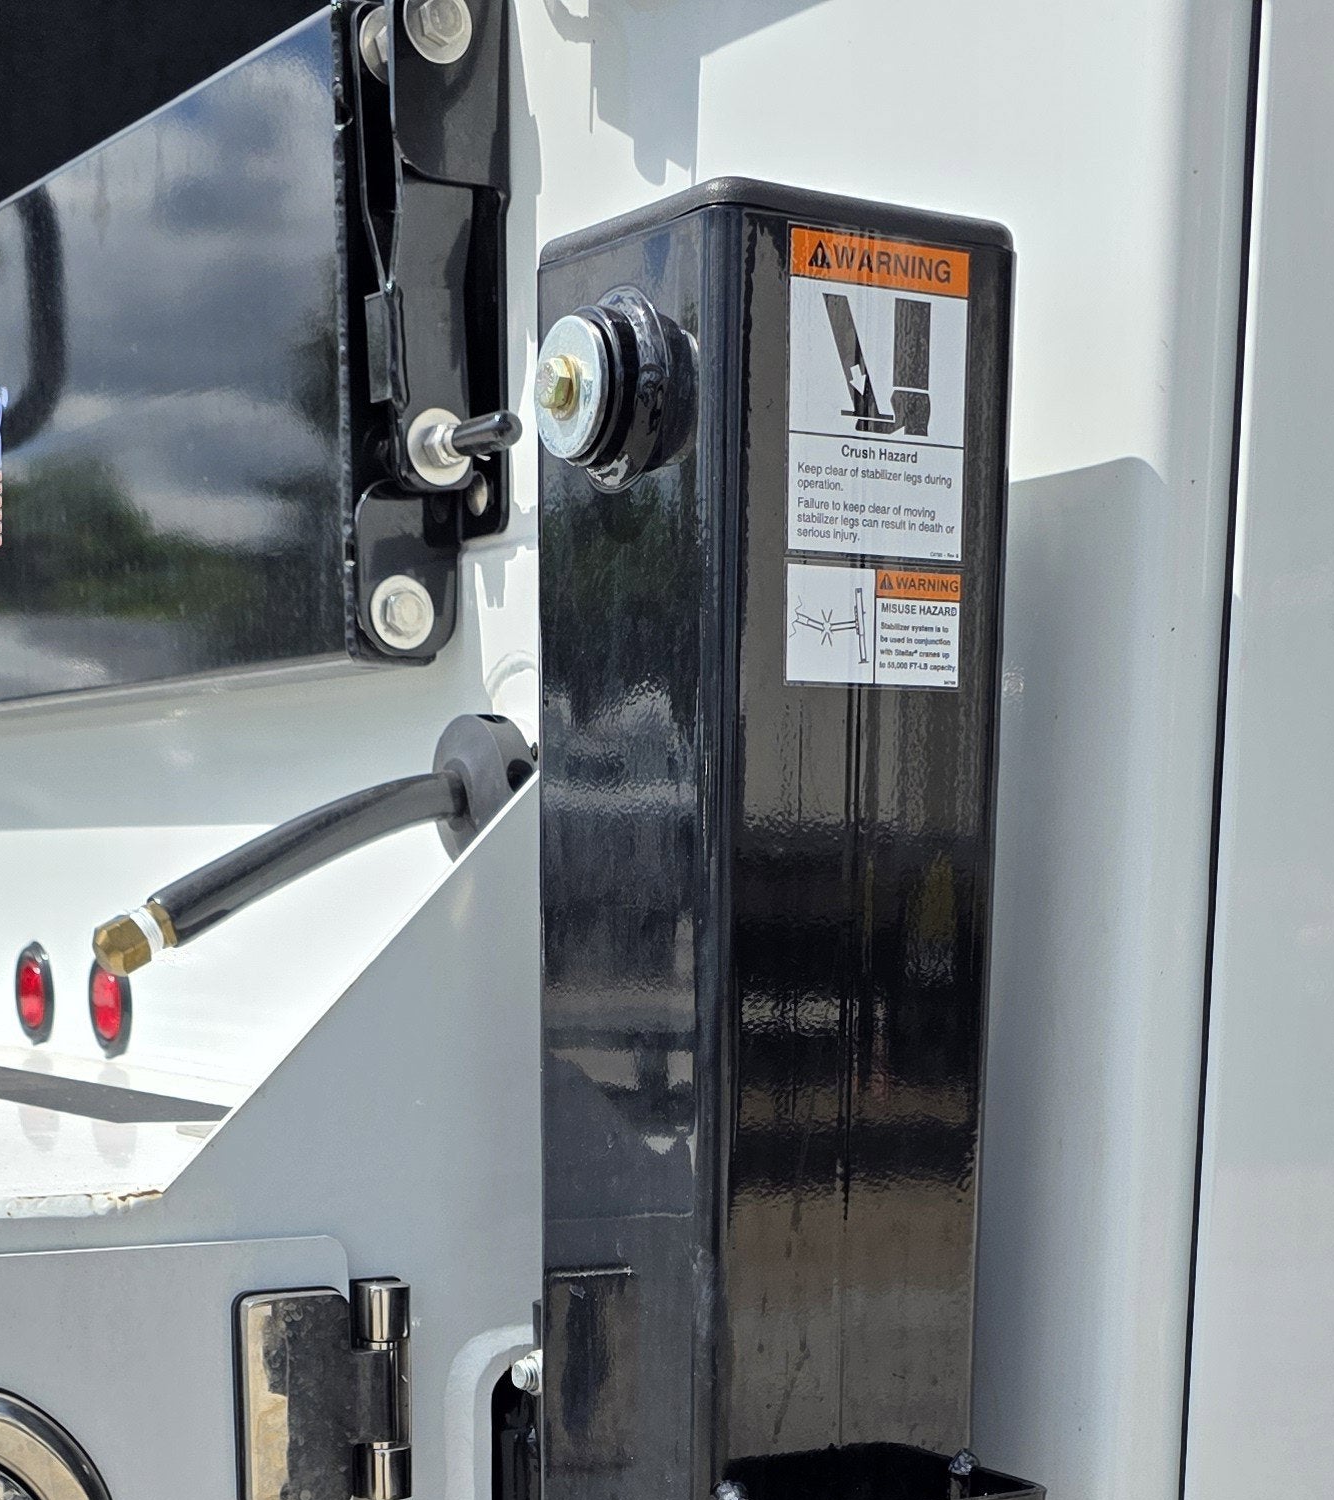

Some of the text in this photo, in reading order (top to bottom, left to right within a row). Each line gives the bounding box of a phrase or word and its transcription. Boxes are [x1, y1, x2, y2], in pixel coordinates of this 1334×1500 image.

[833, 243, 951, 284] WARNING
[841, 444, 918, 463] Crush Hazard
[797, 462, 952, 489] Keep clear of stabilizer legs during
[797, 479, 844, 491] operation.
[797, 497, 936, 521] Failure to keep clear of moving
[797, 513, 955, 534] stabilizer legs can result in death or
[797, 527, 860, 543] serious injury.
[896, 577, 959, 593] WARNING
[881, 602, 957, 617] MISUSE HAZARD
[881, 622, 909, 631] Stabilizer
[911, 624, 934, 633] system
[914, 638, 951, 647] conjunction
[879, 661, 885, 669] to
